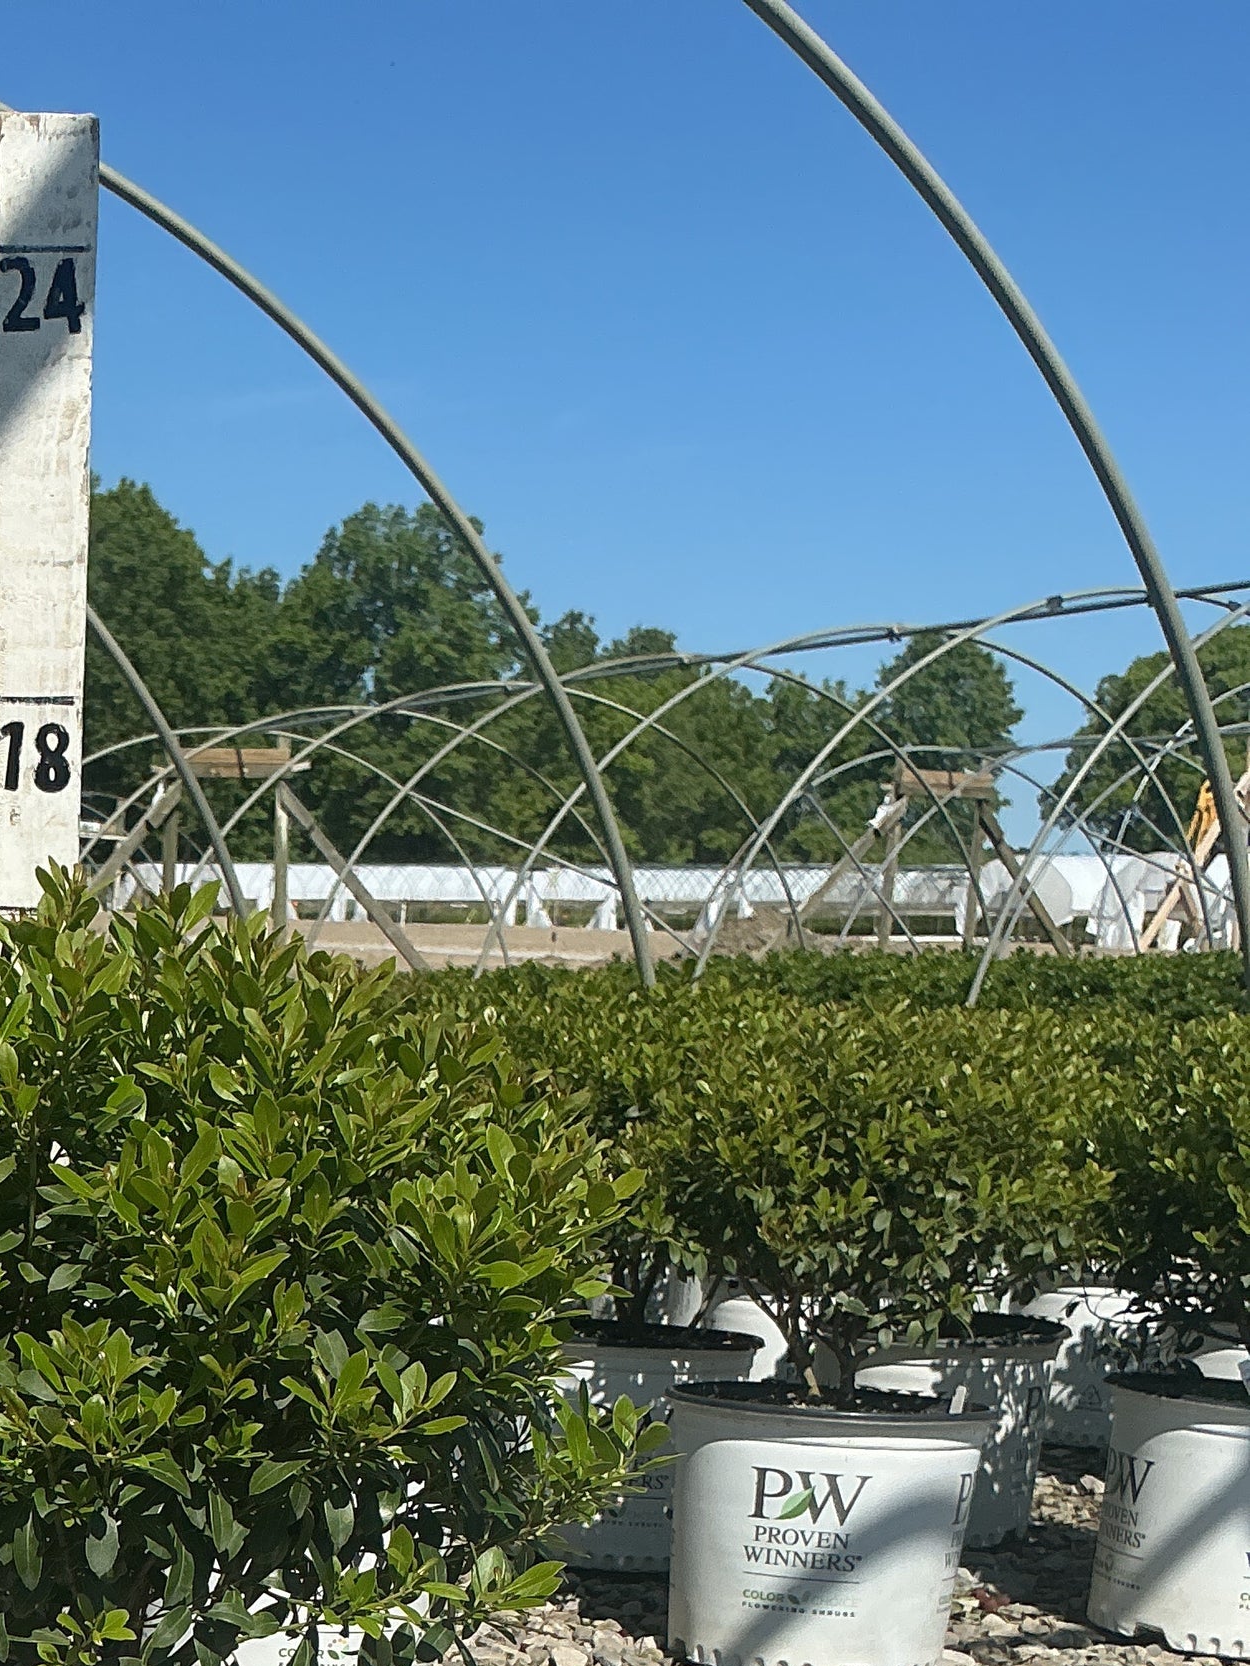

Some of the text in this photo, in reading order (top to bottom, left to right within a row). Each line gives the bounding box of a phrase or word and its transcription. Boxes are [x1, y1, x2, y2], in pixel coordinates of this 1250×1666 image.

[0, 256, 85, 334] 24
[0, 721, 71, 793] 18
[748, 1466, 873, 1527] PW
[753, 1525, 851, 1550] PROVEN
[743, 1589, 784, 1603] COLOR
